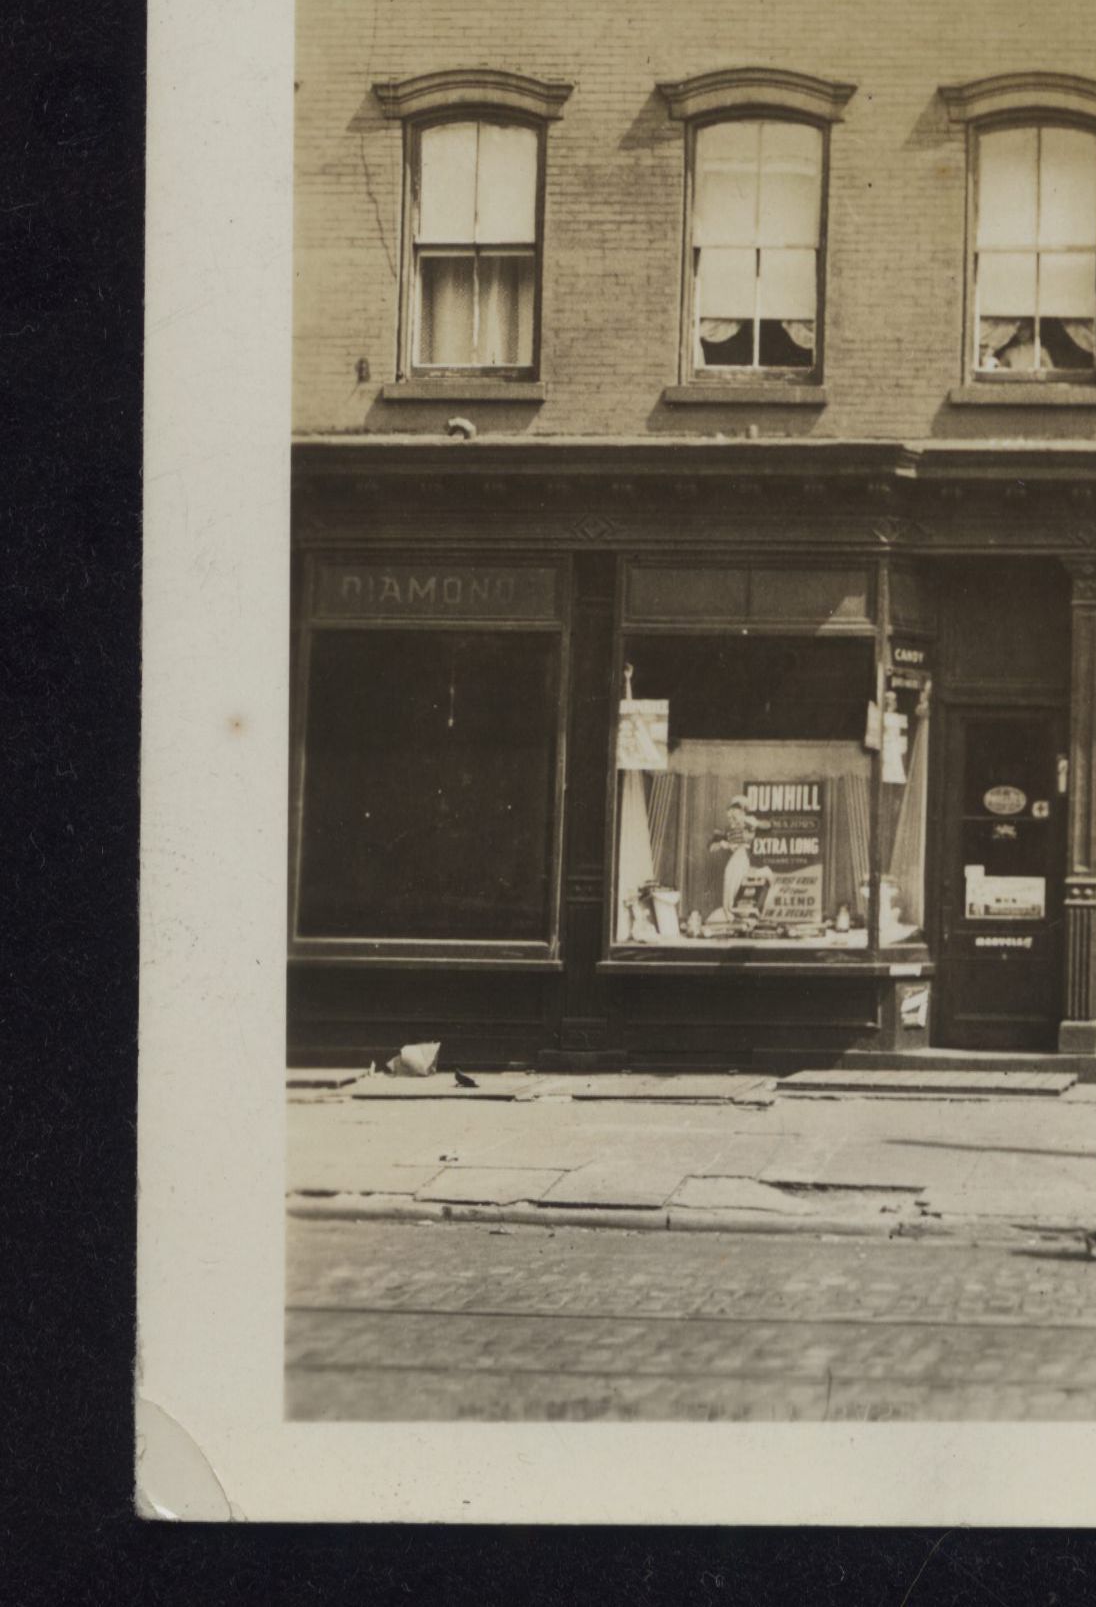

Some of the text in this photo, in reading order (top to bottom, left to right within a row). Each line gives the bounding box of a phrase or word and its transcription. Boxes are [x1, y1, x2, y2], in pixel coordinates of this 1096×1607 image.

[747, 784, 821, 811] DUNHILL
[753, 837, 819, 855] EXTRA LONG
[774, 896, 815, 907] BLEND
